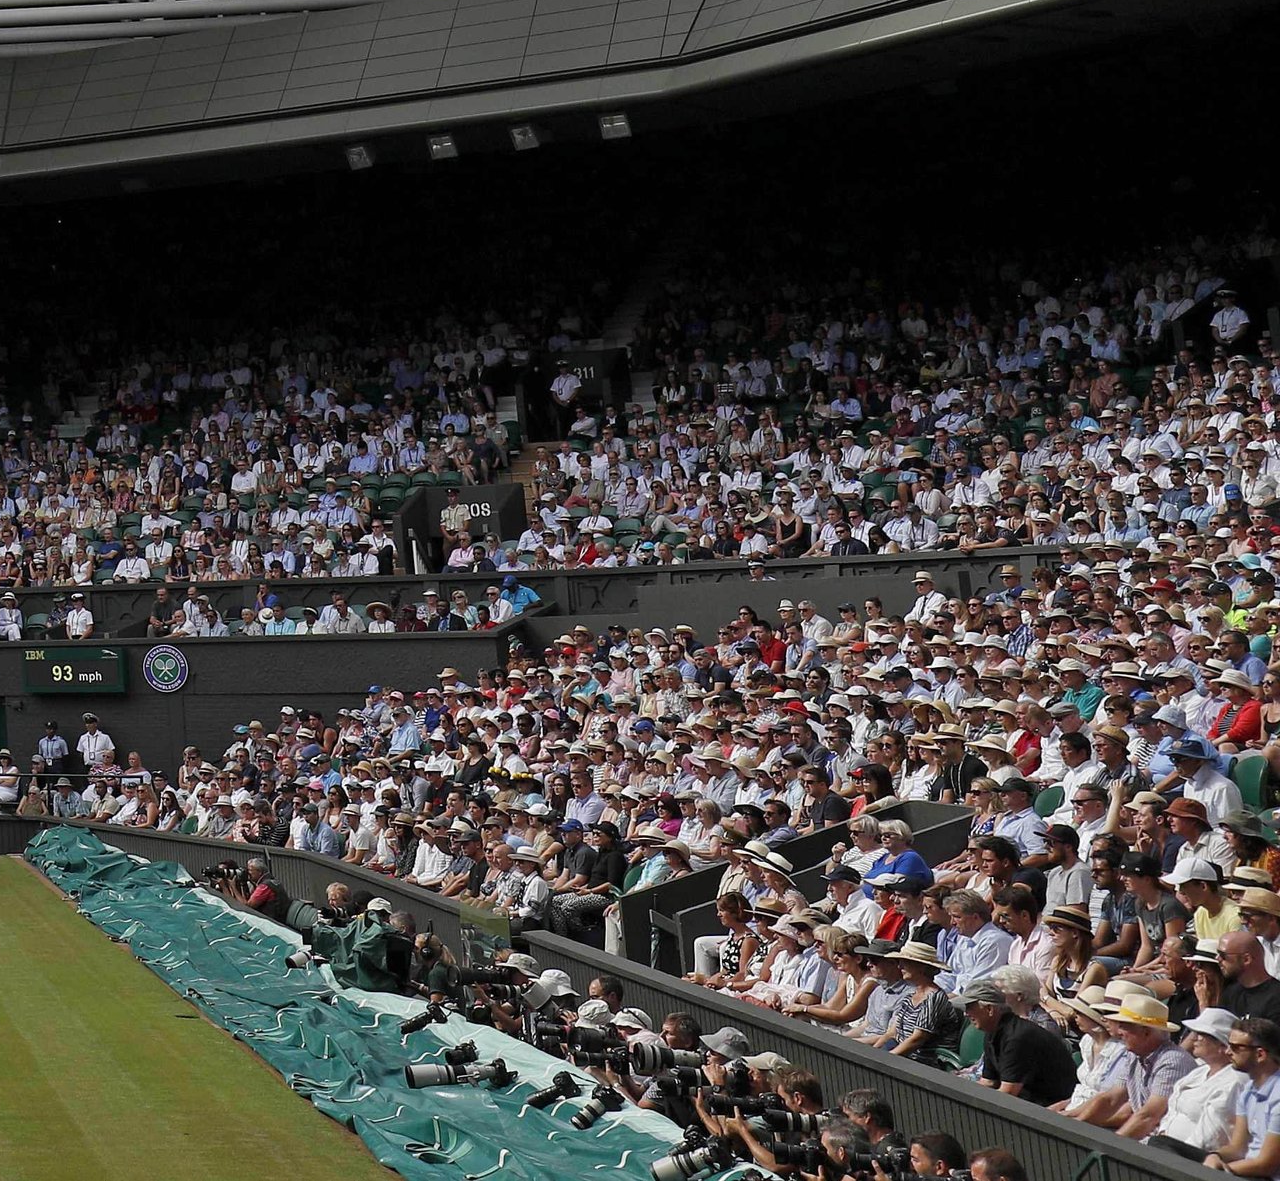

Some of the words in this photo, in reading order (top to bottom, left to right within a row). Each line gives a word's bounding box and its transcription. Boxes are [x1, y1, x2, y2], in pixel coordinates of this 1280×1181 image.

[465, 502, 491, 518] 08
[25, 650, 45, 661] IBM
[52, 665, 73, 682] 93
[78, 670, 103, 684] mph
